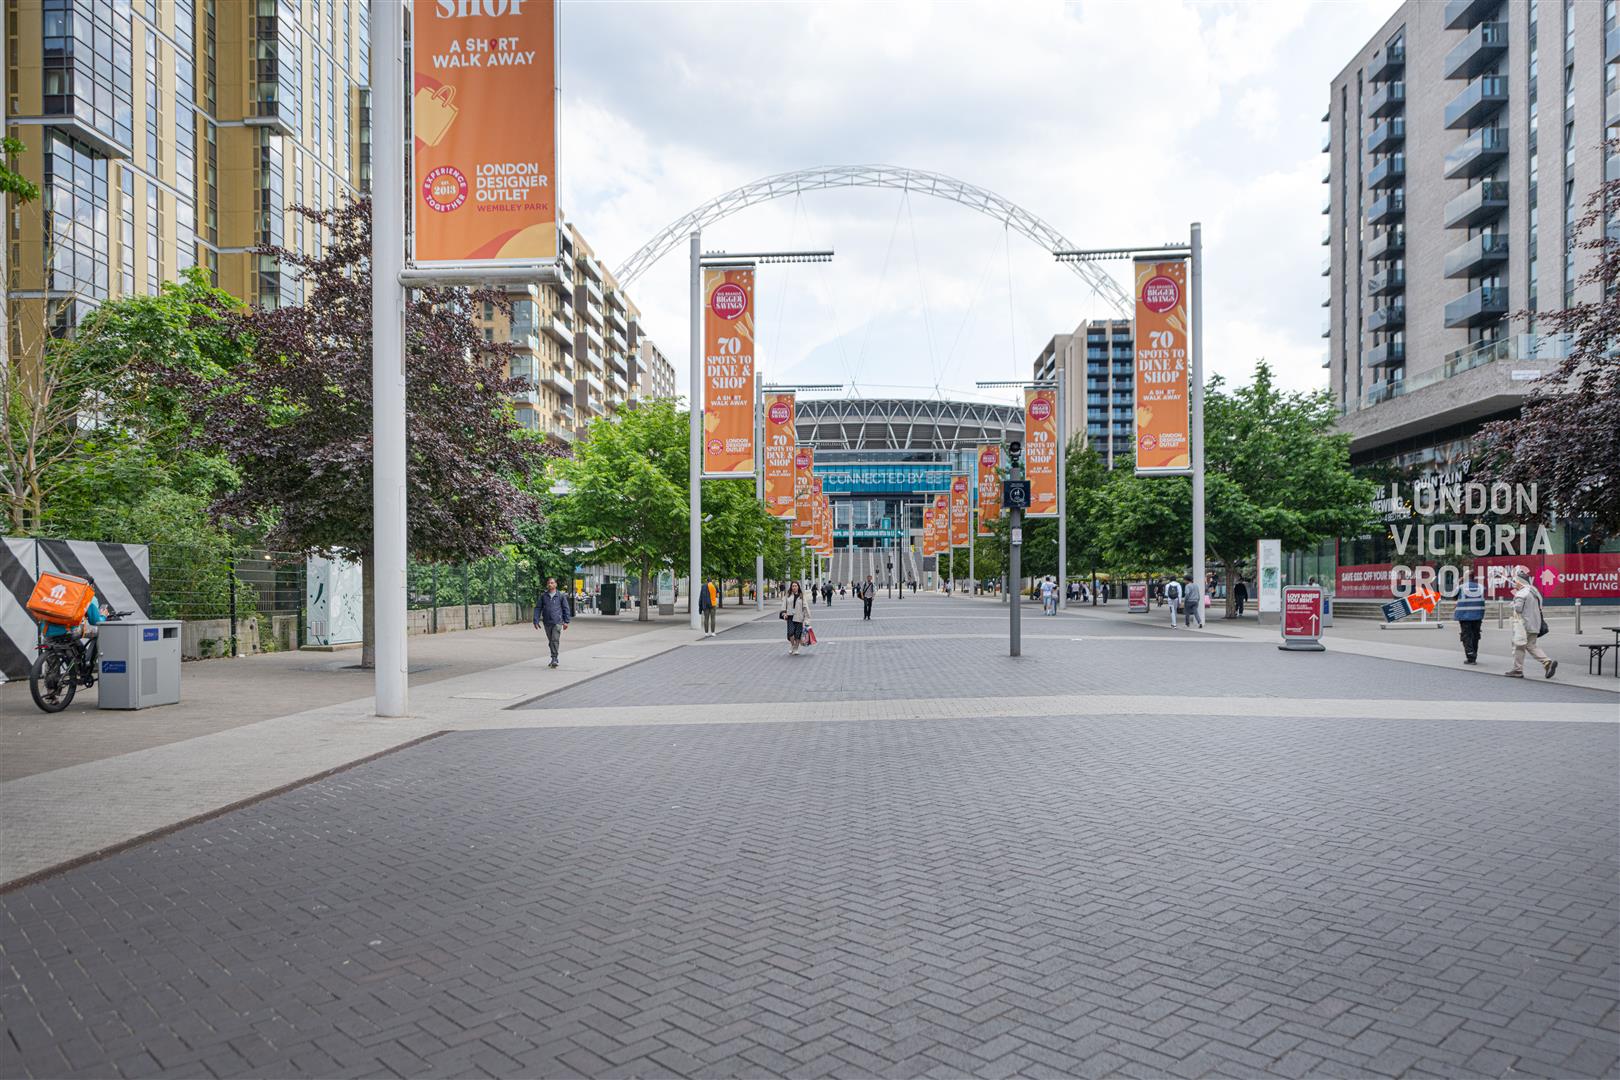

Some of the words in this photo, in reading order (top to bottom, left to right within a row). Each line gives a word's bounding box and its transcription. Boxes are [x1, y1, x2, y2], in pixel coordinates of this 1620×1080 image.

[450, 39, 461, 53] A
[432, 53, 481, 68] WALK
[487, 51, 535, 67] AWAY
[476, 163, 538, 176] LONDON
[424, 167, 467, 189] EXPERIENCE
[476, 175, 548, 188] DESIGNER
[434, 185, 456, 196] 2013
[475, 188, 529, 202] OUTLET
[426, 193, 465, 212] TOGETHER
[477, 204, 521, 212] WEMBLEY
[524, 203, 548, 211] PARK
[1147, 288, 1175, 296] BIGGER
[716, 295, 743, 303] BIGGER
[1147, 295, 1175, 303] SAVINGS
[1149, 330, 1174, 348] 70
[717, 336, 742, 355] 70
[1139, 349, 1169, 359] SPOTS
[1172, 349, 1185, 358] TO
[707, 355, 737, 365] SPOTS
[738, 355, 752, 364] TO
[1139, 359, 1171, 371] DINE
[1175, 359, 1184, 370] &
[707, 365, 738, 377] DINE
[742, 365, 751, 376] &
[1144, 371, 1180, 383] SHOP
[711, 377, 746, 389] SHOP
[773, 435, 787, 445] 70
[1033, 431, 1048, 442] 70
[767, 451, 785, 459] DINE
[1027, 448, 1046, 456] DINE
[829, 473, 905, 484] CONNECTED
[908, 473, 924, 484] BY
[1414, 470, 1462, 491] QUINTAIN
[1363, 572, 1373, 581] OFF
[1557, 573, 1618, 583] QUINTAIN
